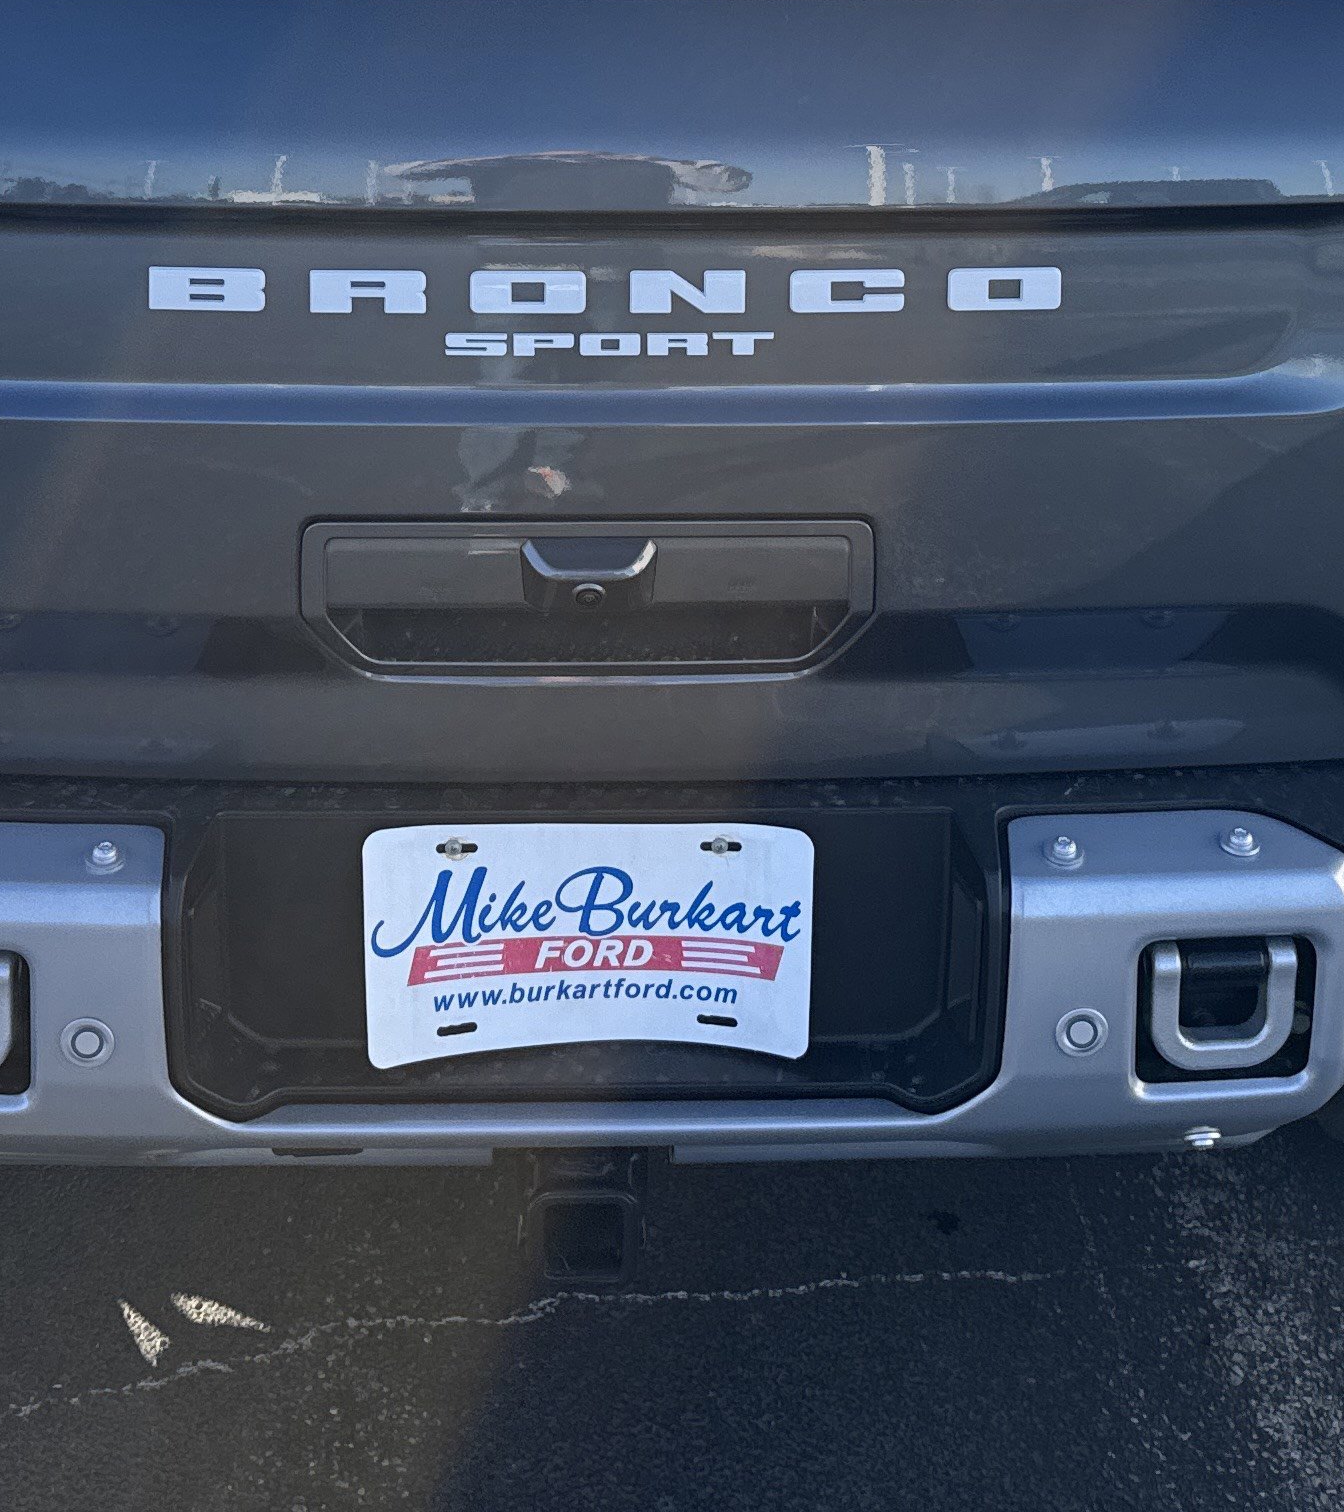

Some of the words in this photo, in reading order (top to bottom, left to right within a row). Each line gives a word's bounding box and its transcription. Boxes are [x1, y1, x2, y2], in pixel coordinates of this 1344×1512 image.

[148, 266, 1062, 315] BRONCO
[444, 331, 775, 357] SPORT
[371, 866, 556, 958] Mike
[555, 866, 803, 942] Burkart
[534, 938, 654, 970] FORD
[433, 977, 739, 1013] www.burkartford.com
